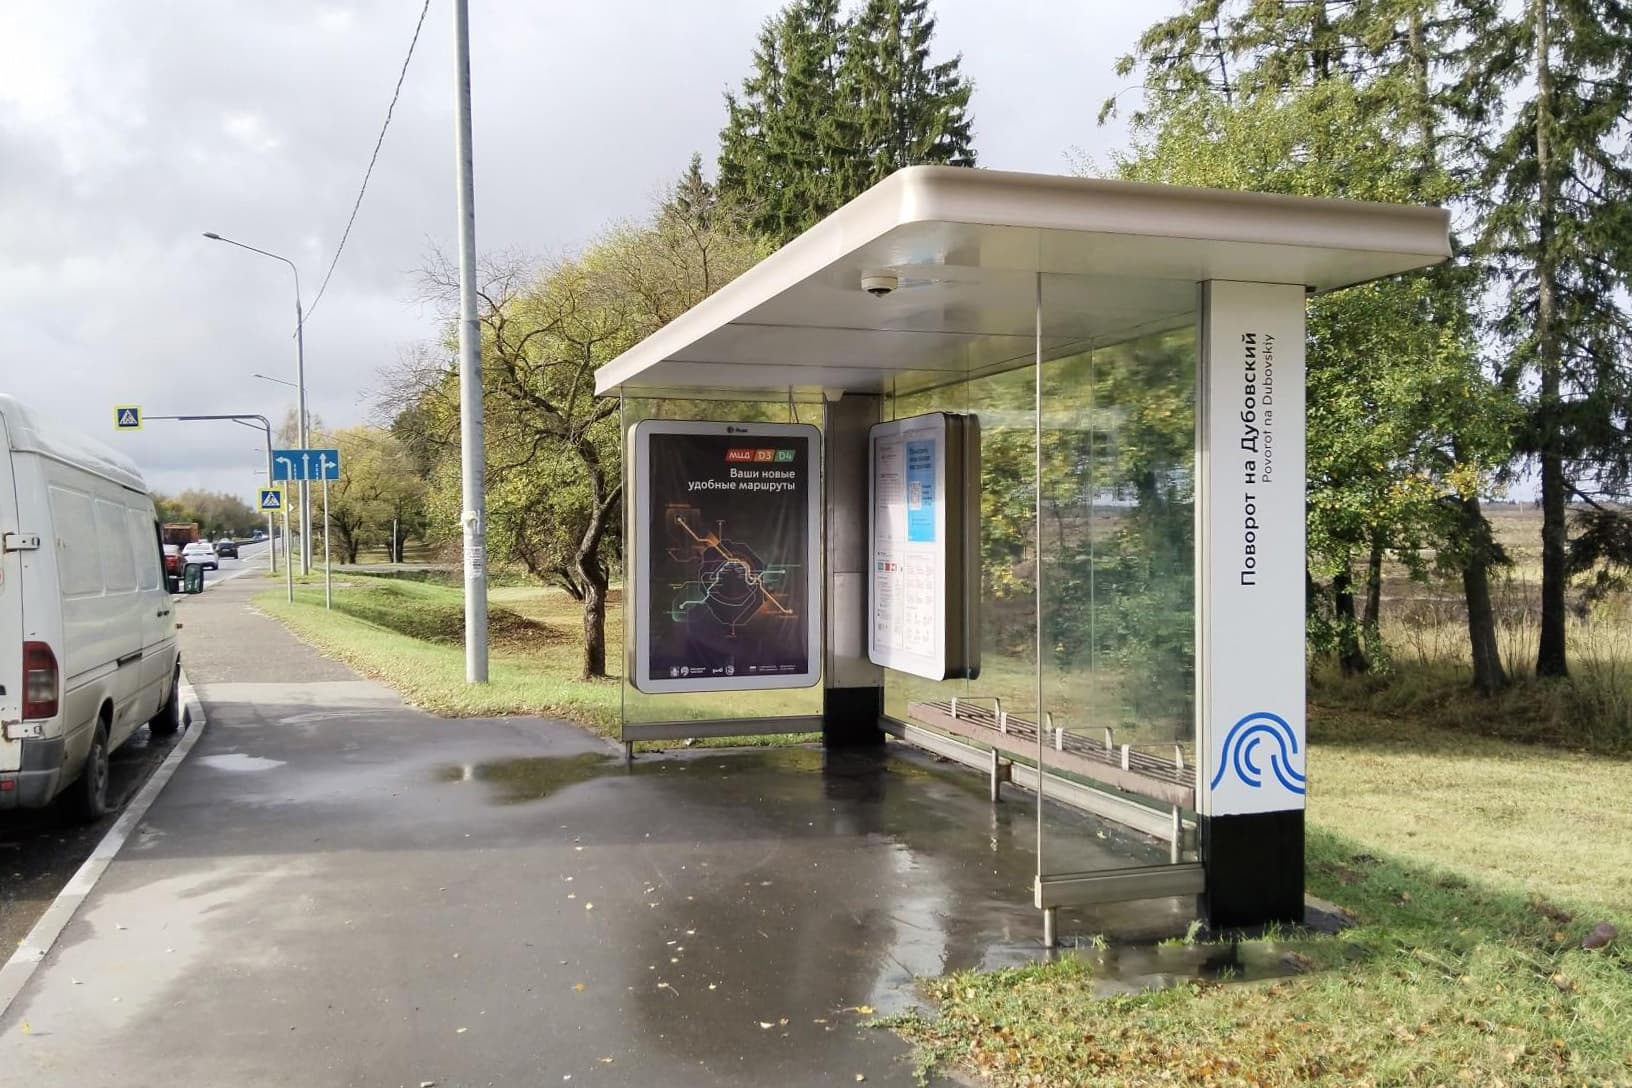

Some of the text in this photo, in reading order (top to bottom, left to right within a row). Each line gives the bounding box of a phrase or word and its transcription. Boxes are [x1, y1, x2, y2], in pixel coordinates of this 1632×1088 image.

[1261, 334, 1275, 483] Povorot na Dubovskiy
[728, 451, 751, 460] МЦД
[1240, 332, 1259, 586] Поворот на Дубовский
[730, 468, 796, 479] Ваши новые
[687, 480, 796, 492] удобные маршруты
